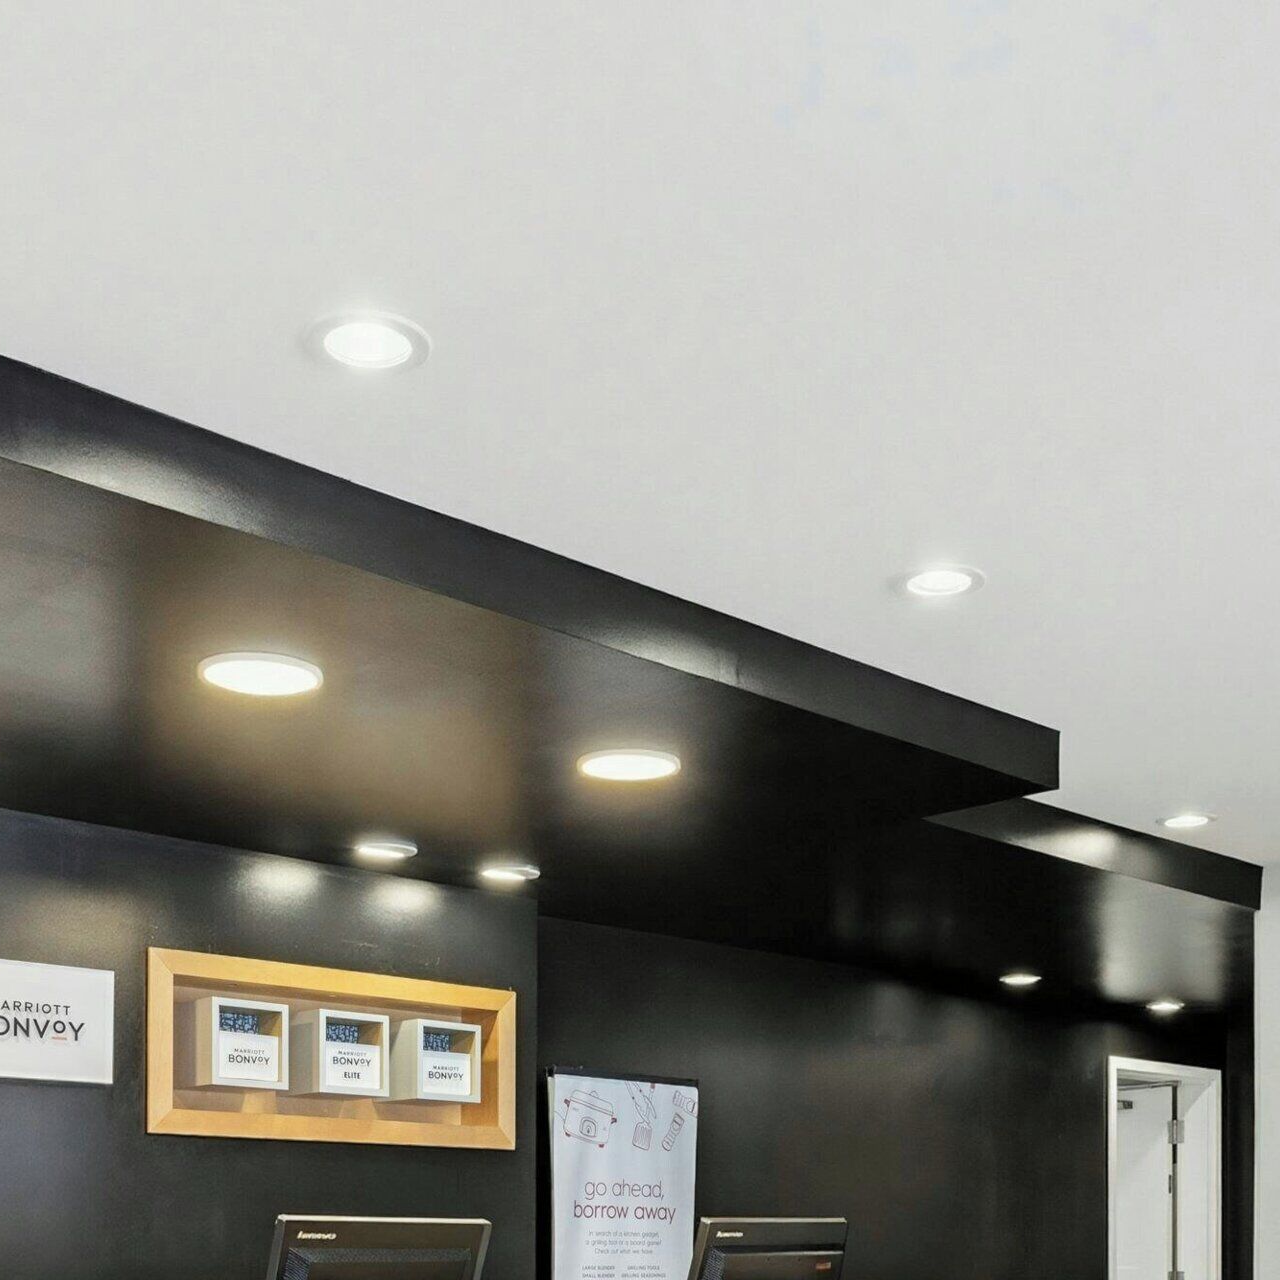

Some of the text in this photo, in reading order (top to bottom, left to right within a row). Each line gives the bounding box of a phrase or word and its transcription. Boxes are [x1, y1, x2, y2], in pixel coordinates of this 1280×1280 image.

[234, 1047, 266, 1056] MARRIOTT
[433, 1064, 460, 1072] MARRIOTT
[344, 1071, 361, 1080] ELITE
[585, 1178, 665, 1201] go ahead,
[574, 1199, 677, 1225] borrow away
